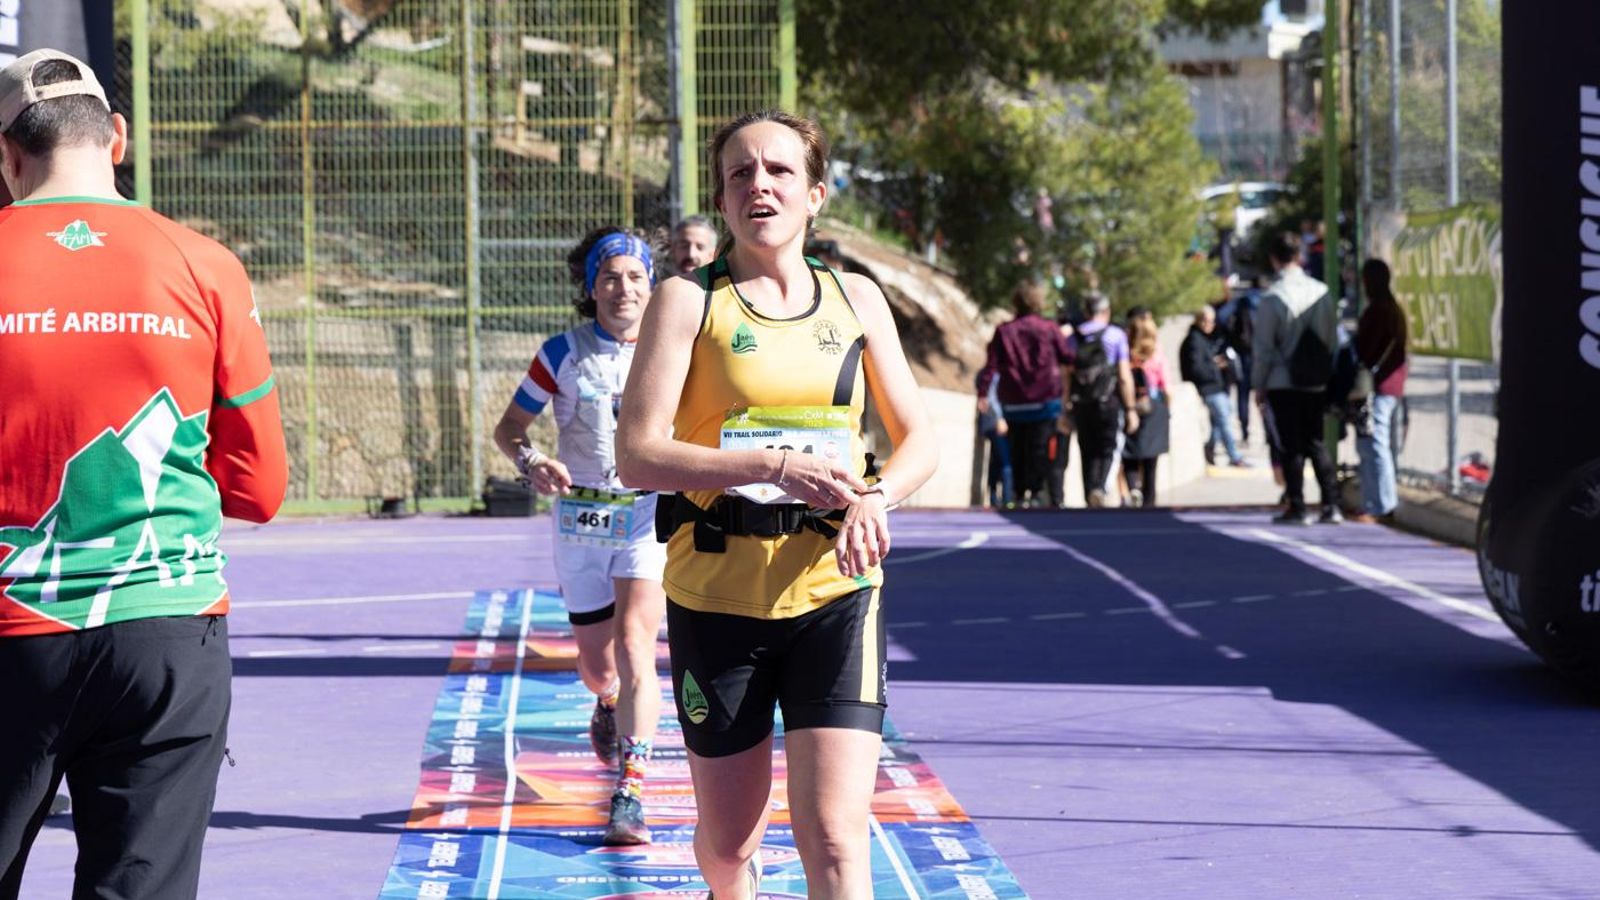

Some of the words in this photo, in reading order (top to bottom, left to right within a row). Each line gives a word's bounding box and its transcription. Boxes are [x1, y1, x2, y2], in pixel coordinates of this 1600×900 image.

[63, 311, 191, 339] ARBITRAL
[751, 430, 783, 438] SOLIDARIO
[577, 511, 611, 529] 461
